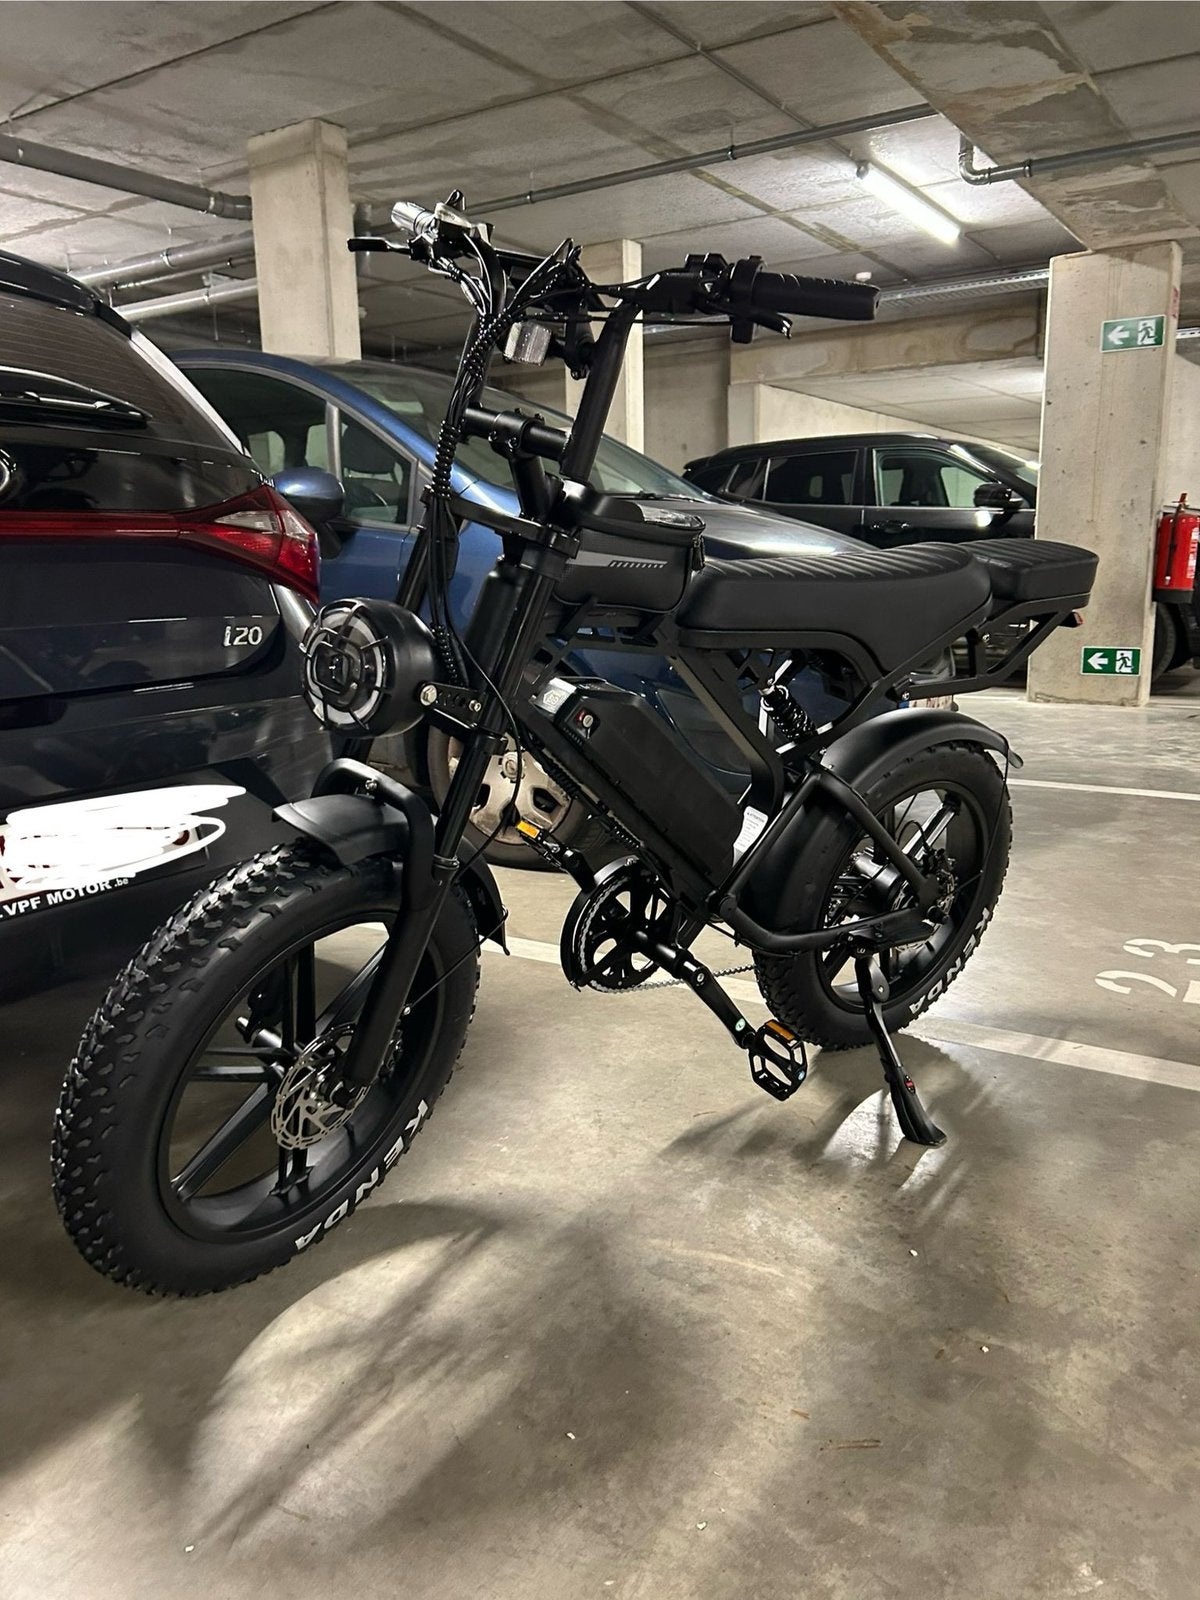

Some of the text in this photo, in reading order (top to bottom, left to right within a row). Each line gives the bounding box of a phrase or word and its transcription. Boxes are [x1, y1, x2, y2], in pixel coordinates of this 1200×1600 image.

[223, 625, 263, 647] i20
[2, 896, 41, 917] VPF
[908, 907, 990, 1015] KENDA
[294, 1099, 428, 1250] KENDA
